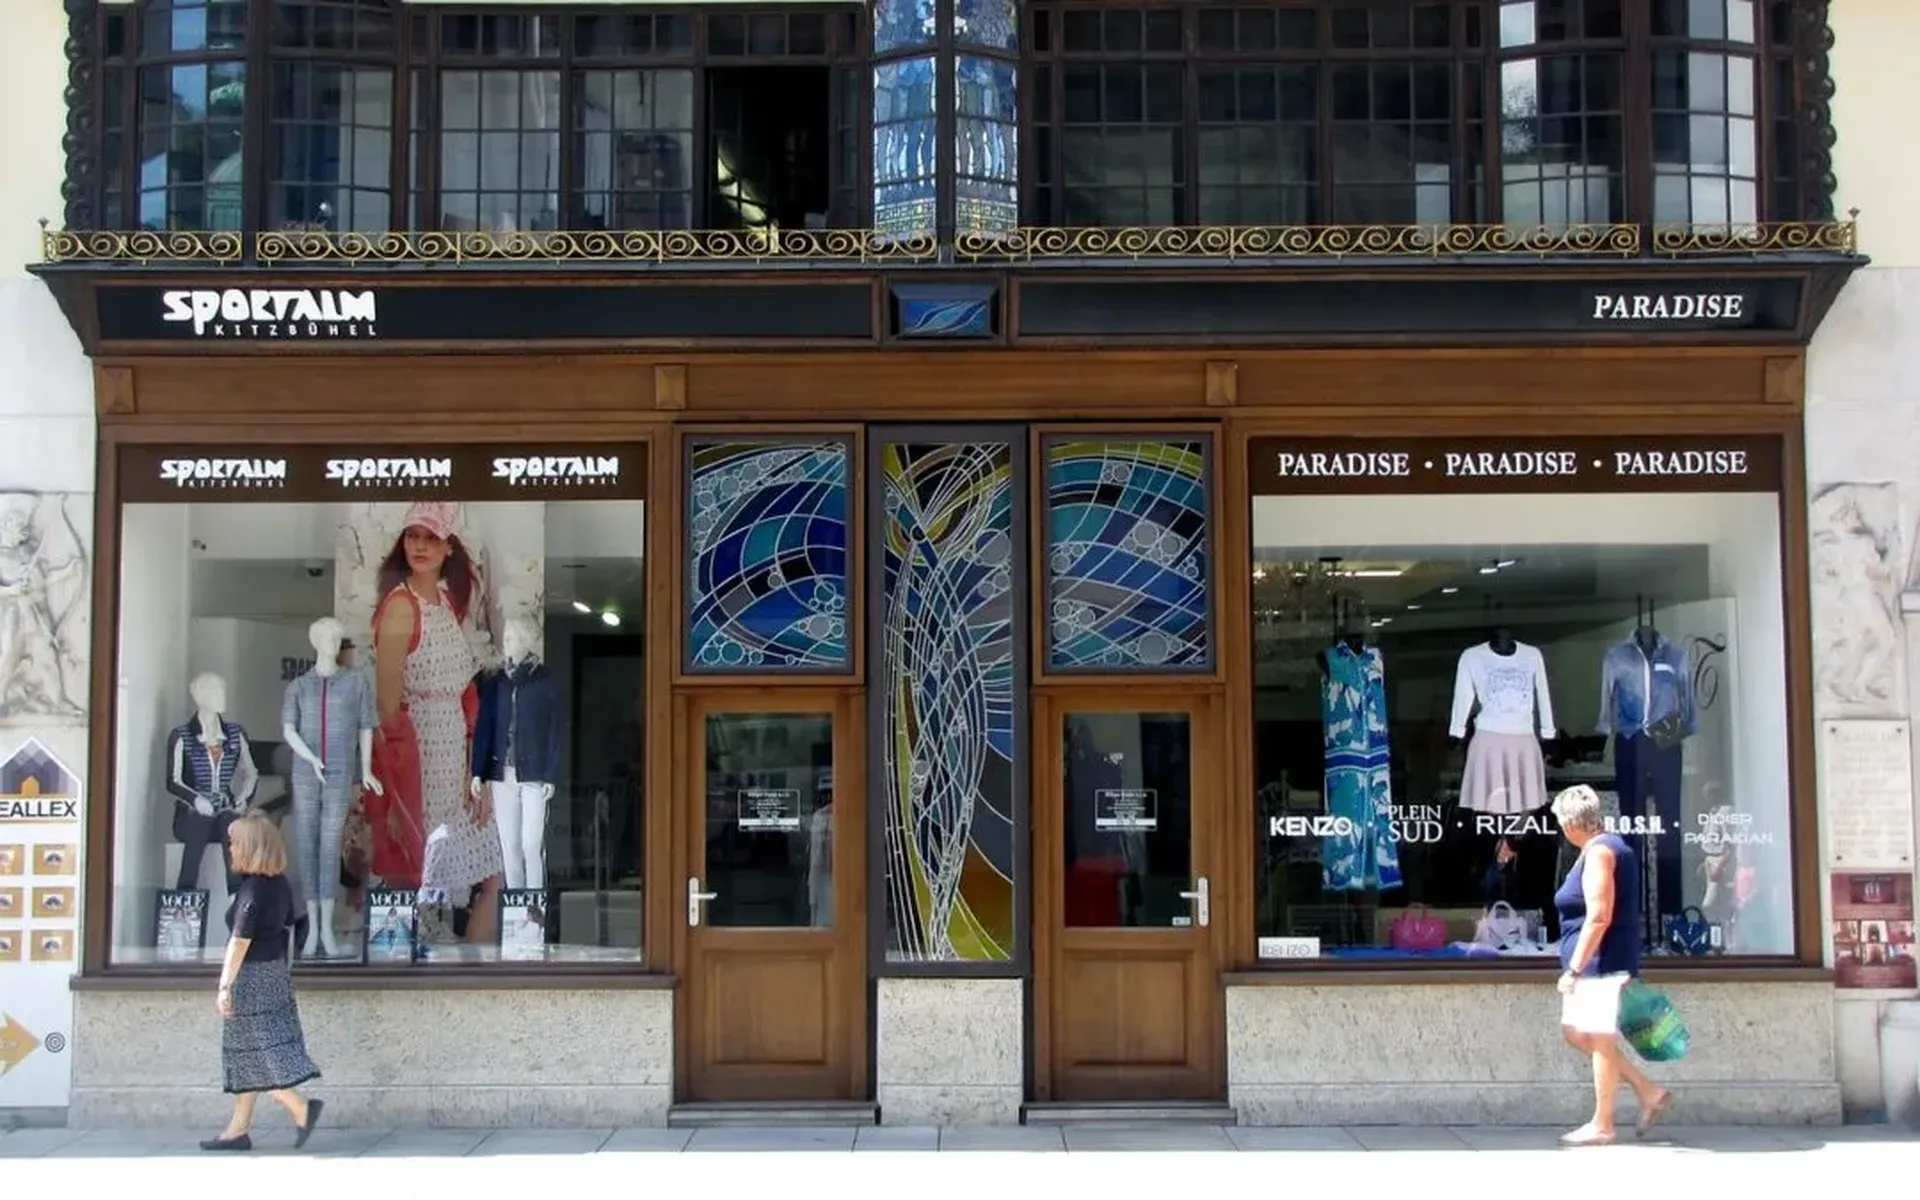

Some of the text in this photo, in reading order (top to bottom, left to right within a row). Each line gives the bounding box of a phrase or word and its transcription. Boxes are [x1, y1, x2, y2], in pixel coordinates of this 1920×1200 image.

[163, 289, 376, 335] SPORTALM
[1593, 294, 1743, 319] PARADISE
[214, 322, 376, 335] KITZBÜHEL
[160, 457, 618, 487] SPORTALM SPORTALM SPORTALM
[1278, 451, 1747, 476] PARADISE PARADISE PARADISE
[1387, 805, 1441, 820] PLEIN
[1697, 813, 1753, 826] DIDIER
[1270, 816, 1351, 836] KENZO
[1387, 821, 1443, 842] SUD
[1476, 815, 1557, 835] RIZAL
[162, 892, 206, 907] VOGUE
[371, 890, 415, 906] VOGUE
[503, 891, 548, 907] VOGUE
